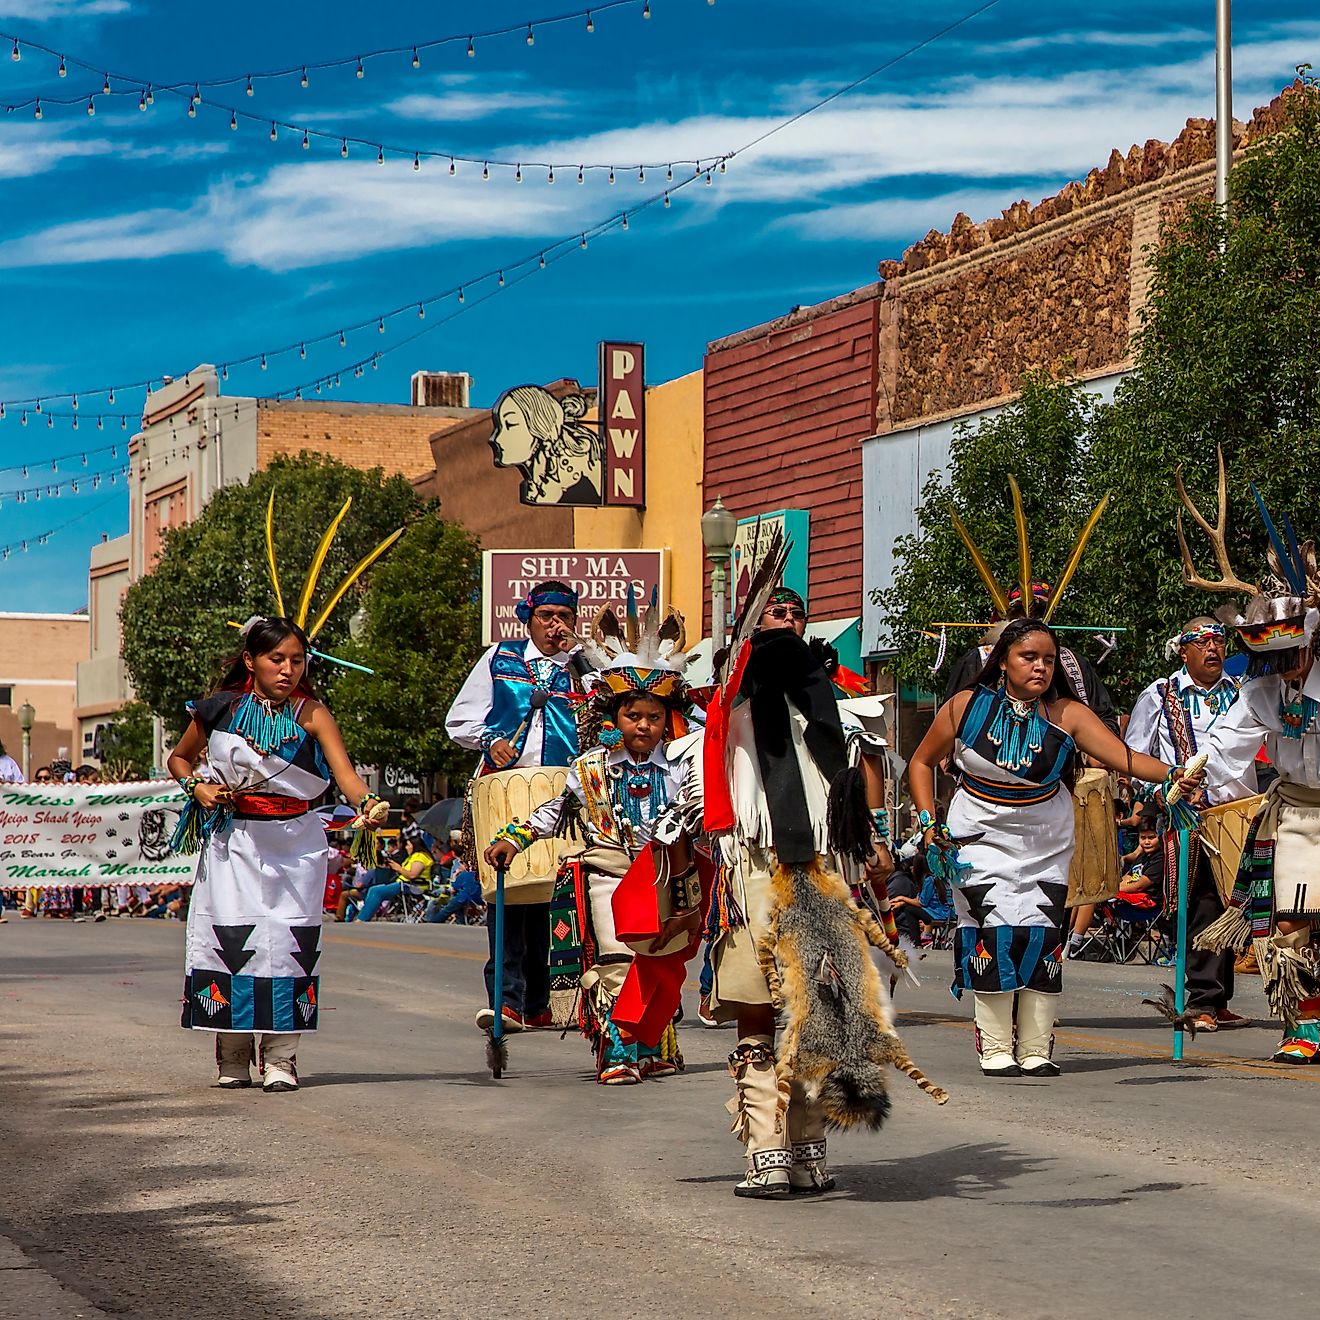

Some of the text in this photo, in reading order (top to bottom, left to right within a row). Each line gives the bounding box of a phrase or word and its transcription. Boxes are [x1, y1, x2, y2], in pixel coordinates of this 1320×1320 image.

[609, 350, 640, 498] PAWN
[521, 557, 631, 577] SHI' MA
[2, 792, 75, 807] Miss
[33, 811, 69, 824] Shash
[72, 810, 103, 828] Yeigo
[3, 833, 40, 845] 2018
[61, 833, 97, 844] 2019
[0, 850, 16, 861] Go
[21, 849, 56, 859] Bears
[6, 863, 193, 878] Mariah Mariano
